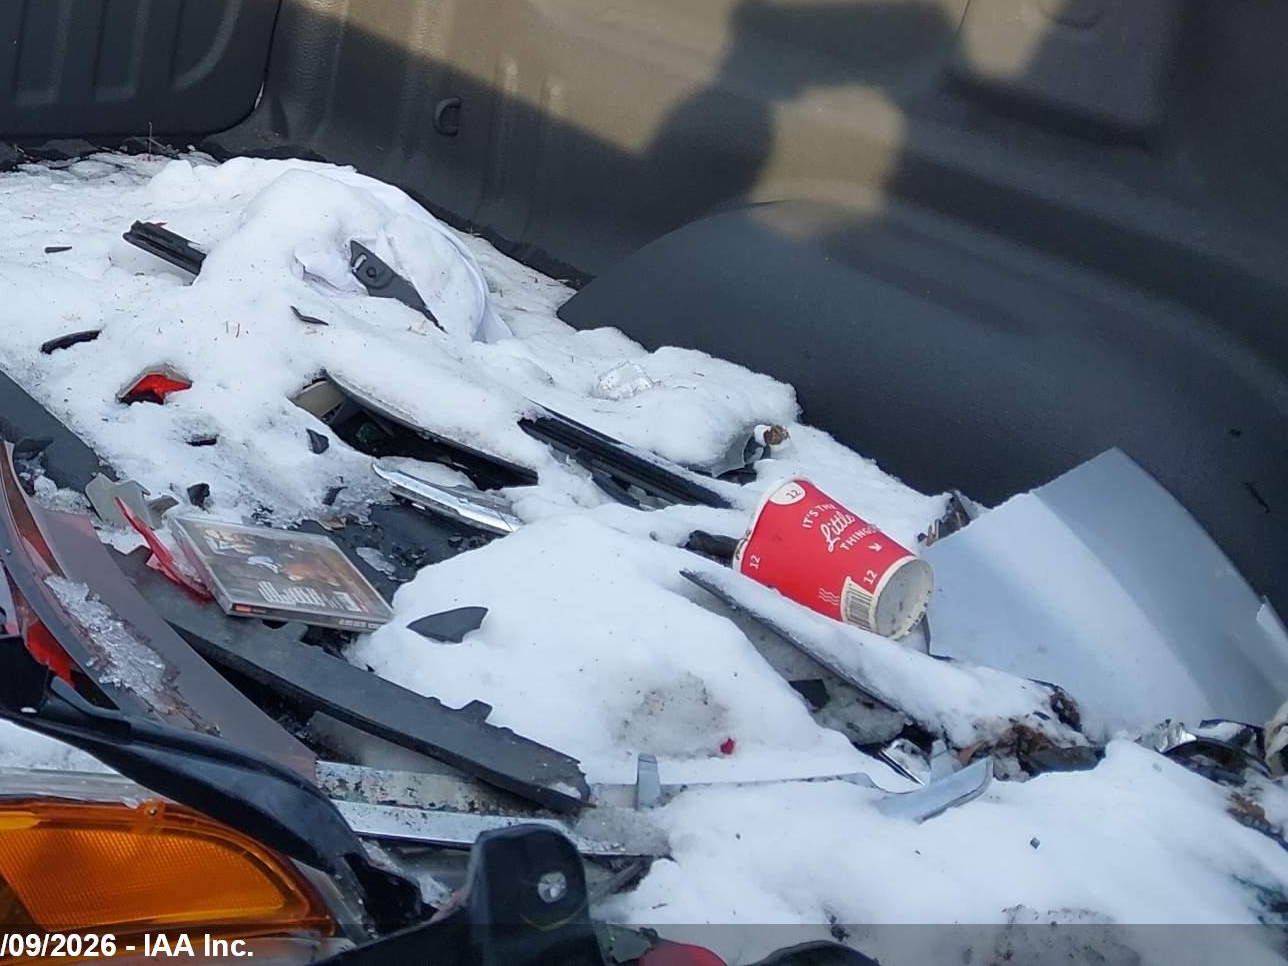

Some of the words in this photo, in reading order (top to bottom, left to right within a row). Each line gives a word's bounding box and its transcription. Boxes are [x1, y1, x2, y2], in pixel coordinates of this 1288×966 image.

[786, 489, 801, 500] 12
[802, 509, 819, 528] IT'S
[820, 510, 855, 552] Little
[749, 554, 761, 569] 12
[863, 569, 878, 585] 12
